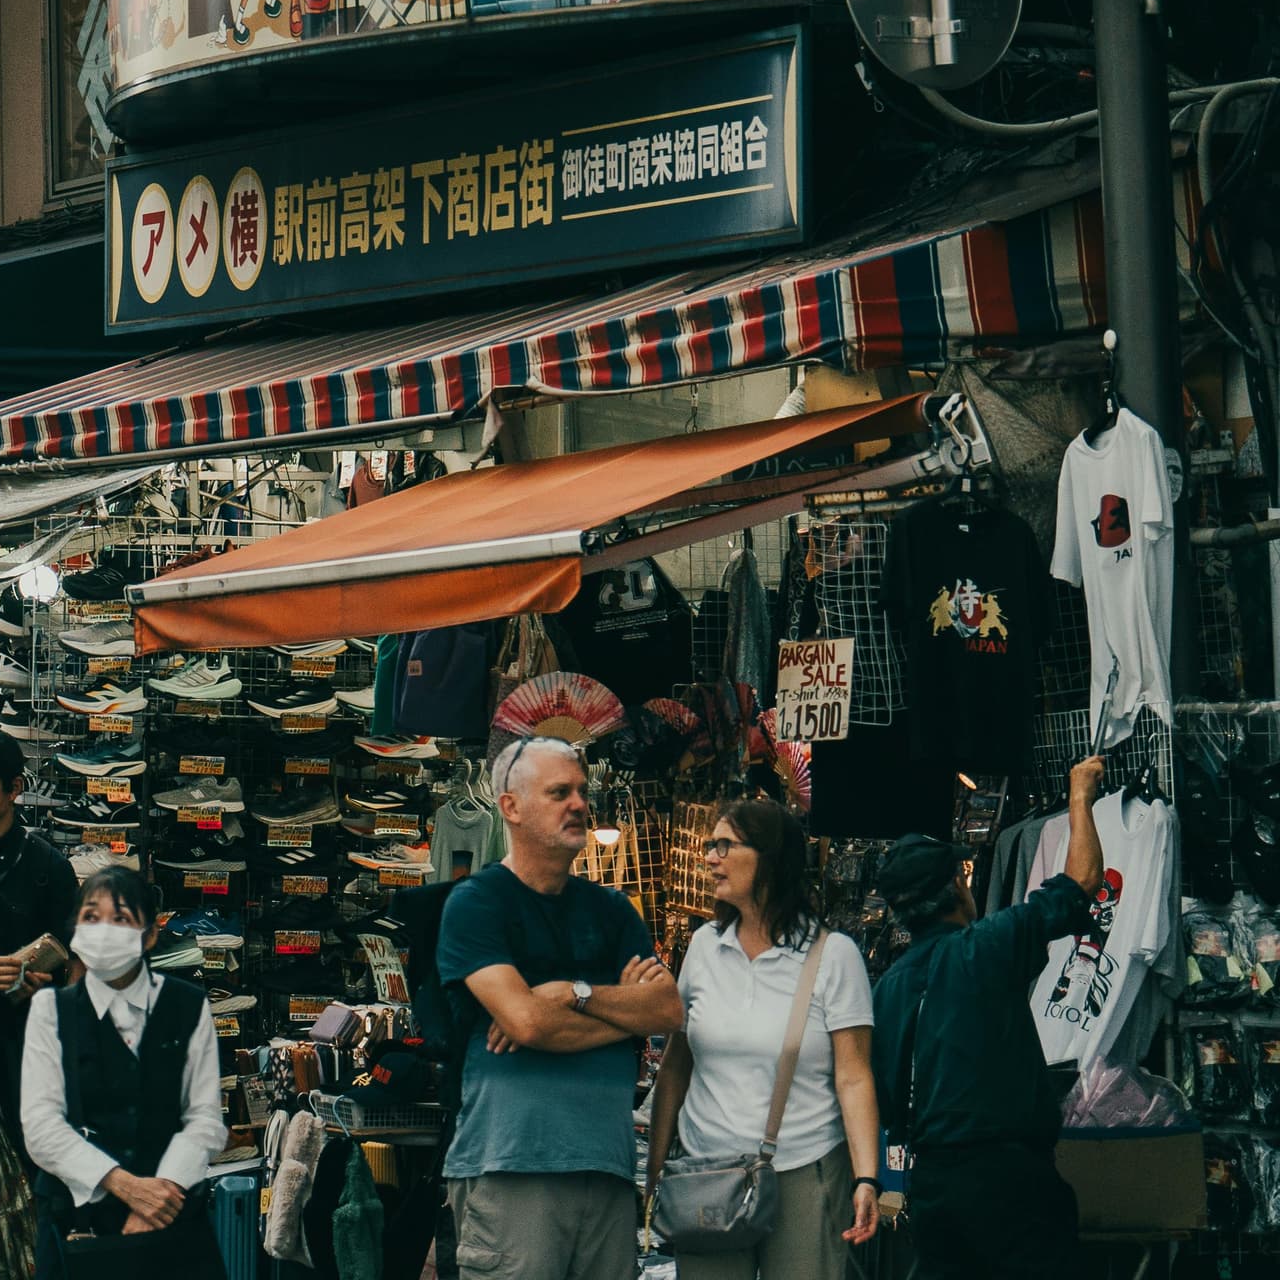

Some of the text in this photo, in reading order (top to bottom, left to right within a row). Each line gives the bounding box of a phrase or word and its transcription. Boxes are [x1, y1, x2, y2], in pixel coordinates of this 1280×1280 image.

[561, 116, 769, 200] 御徒町商栄協同組合
[139, 138, 555, 277] アメ横 駅前高架下商店街
[949, 578, 981, 619] 侍
[779, 643, 836, 671] BARGAIN
[800, 663, 848, 688] SALE
[780, 685, 820, 704] T-shirt
